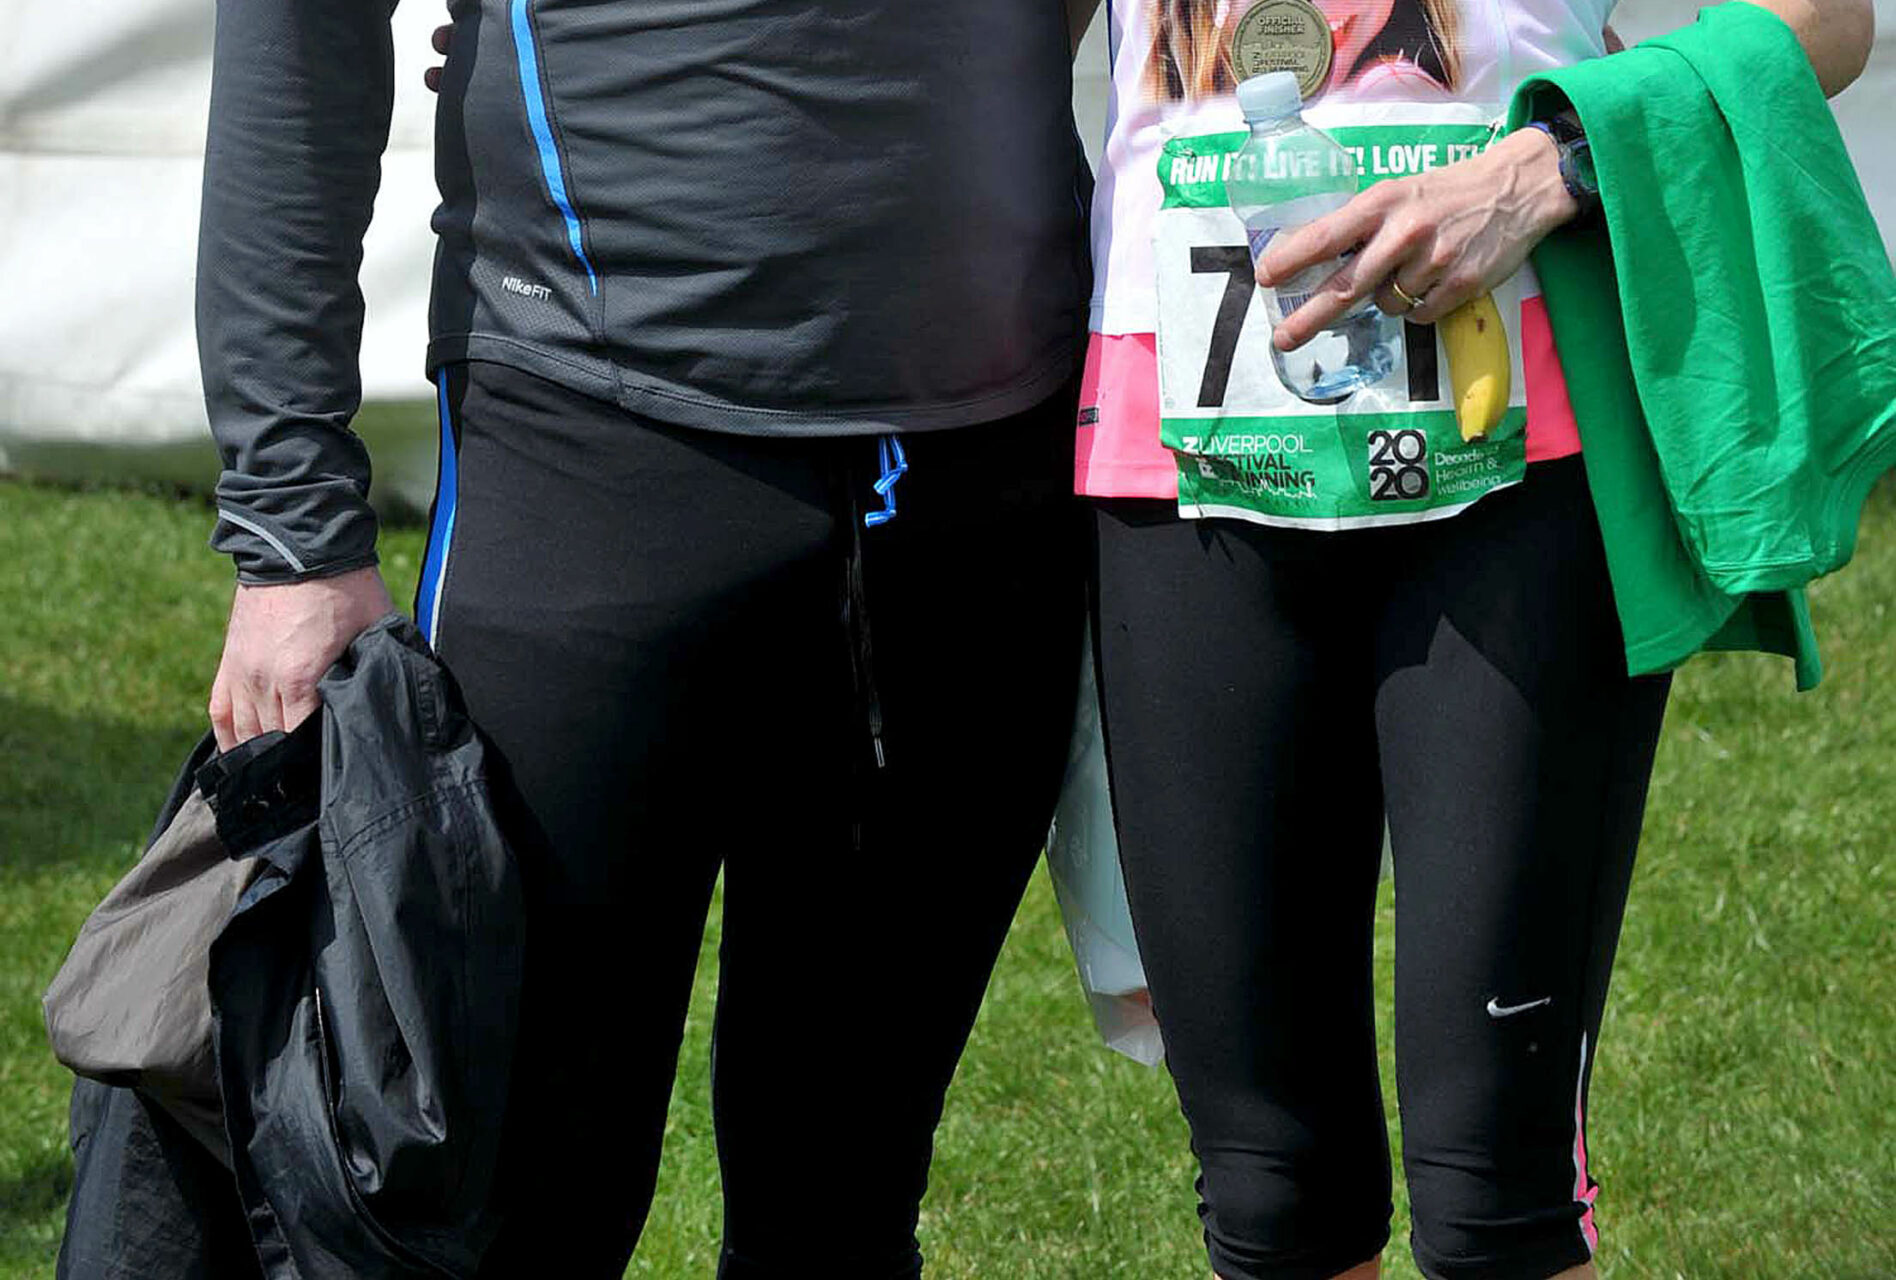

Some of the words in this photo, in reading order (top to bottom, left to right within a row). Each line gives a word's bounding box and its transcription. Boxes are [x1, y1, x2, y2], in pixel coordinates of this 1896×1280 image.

[1258, 15, 1305, 25] OFFICIAL
[1170, 155, 1219, 186] RUN
[1262, 148, 1323, 179] LIVE
[1372, 144, 1438, 175] LOVE
[1199, 434, 1314, 455] LIVERPOOL
[1368, 429, 1427, 466] 20
[1370, 466, 1430, 501] 20
